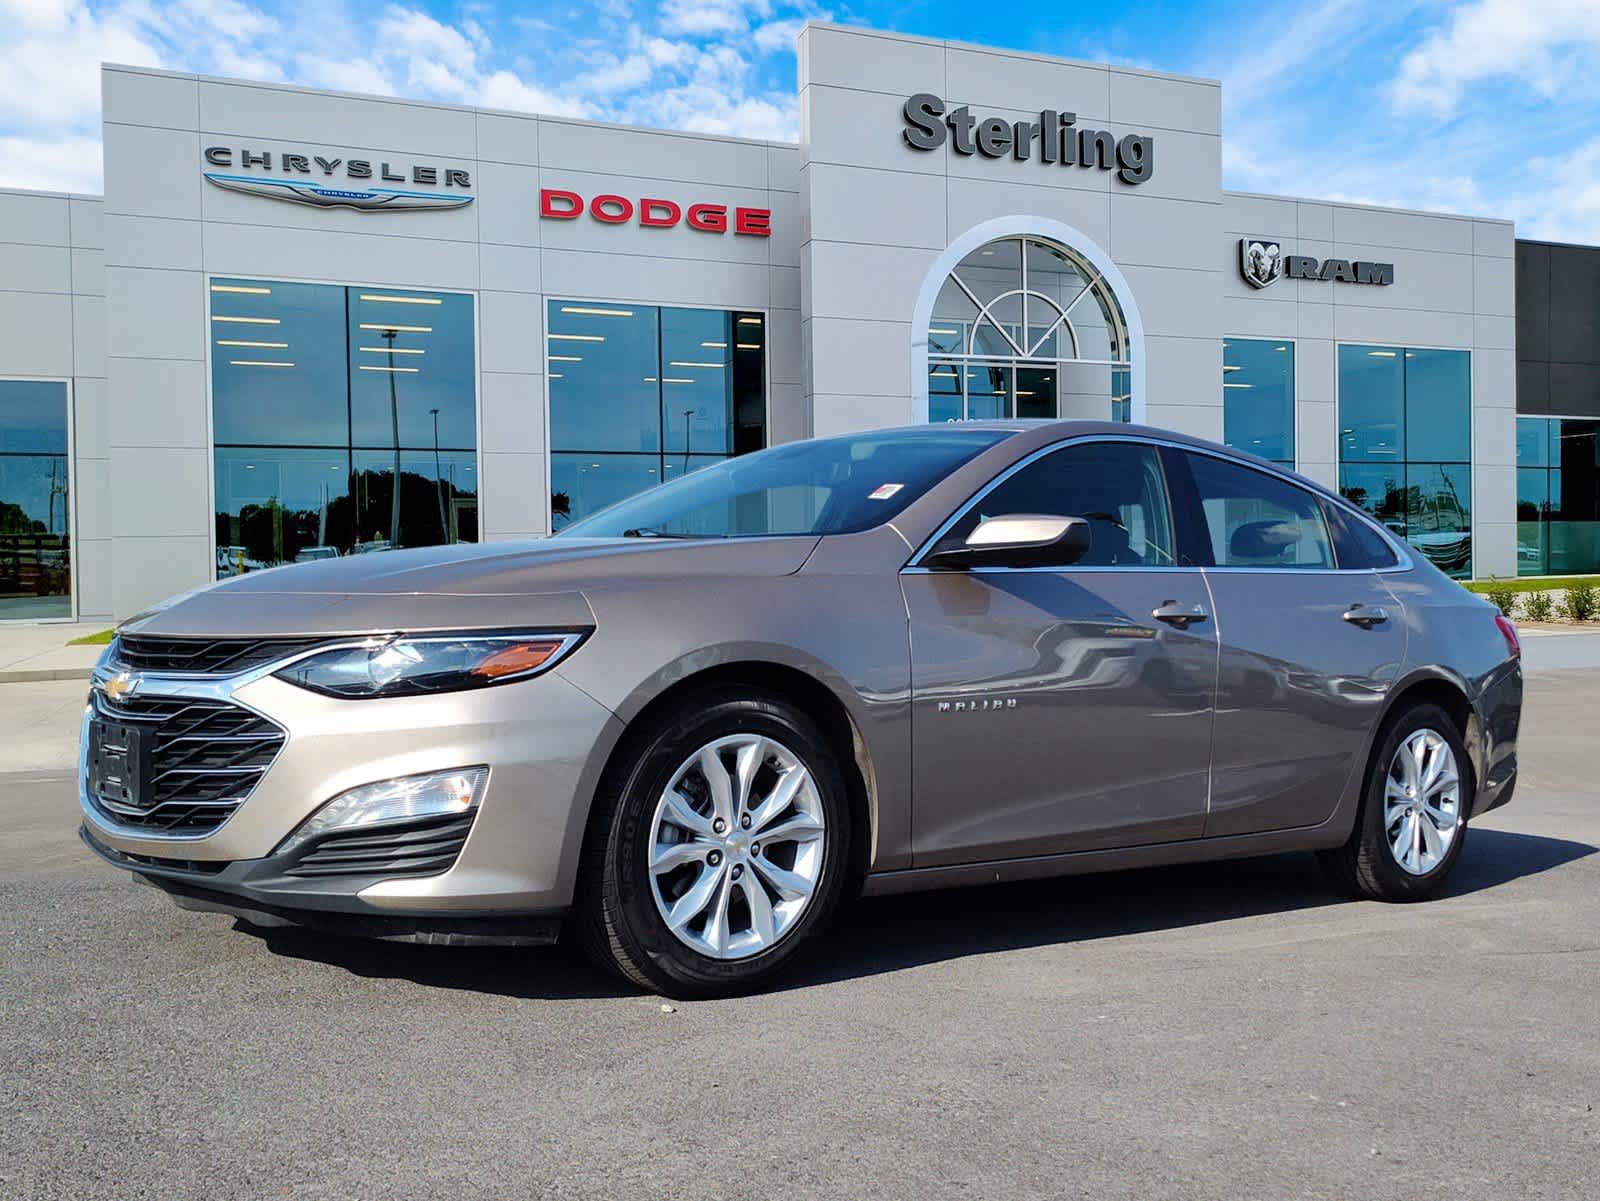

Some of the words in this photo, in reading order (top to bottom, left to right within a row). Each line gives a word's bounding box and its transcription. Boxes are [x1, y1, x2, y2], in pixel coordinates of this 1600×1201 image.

[903, 93, 1154, 185] Sterling
[204, 146, 472, 187] CHRYSLER
[540, 188, 772, 238] DODGE
[1285, 255, 1394, 286] RAM
[937, 698, 1018, 712] MALIBU
